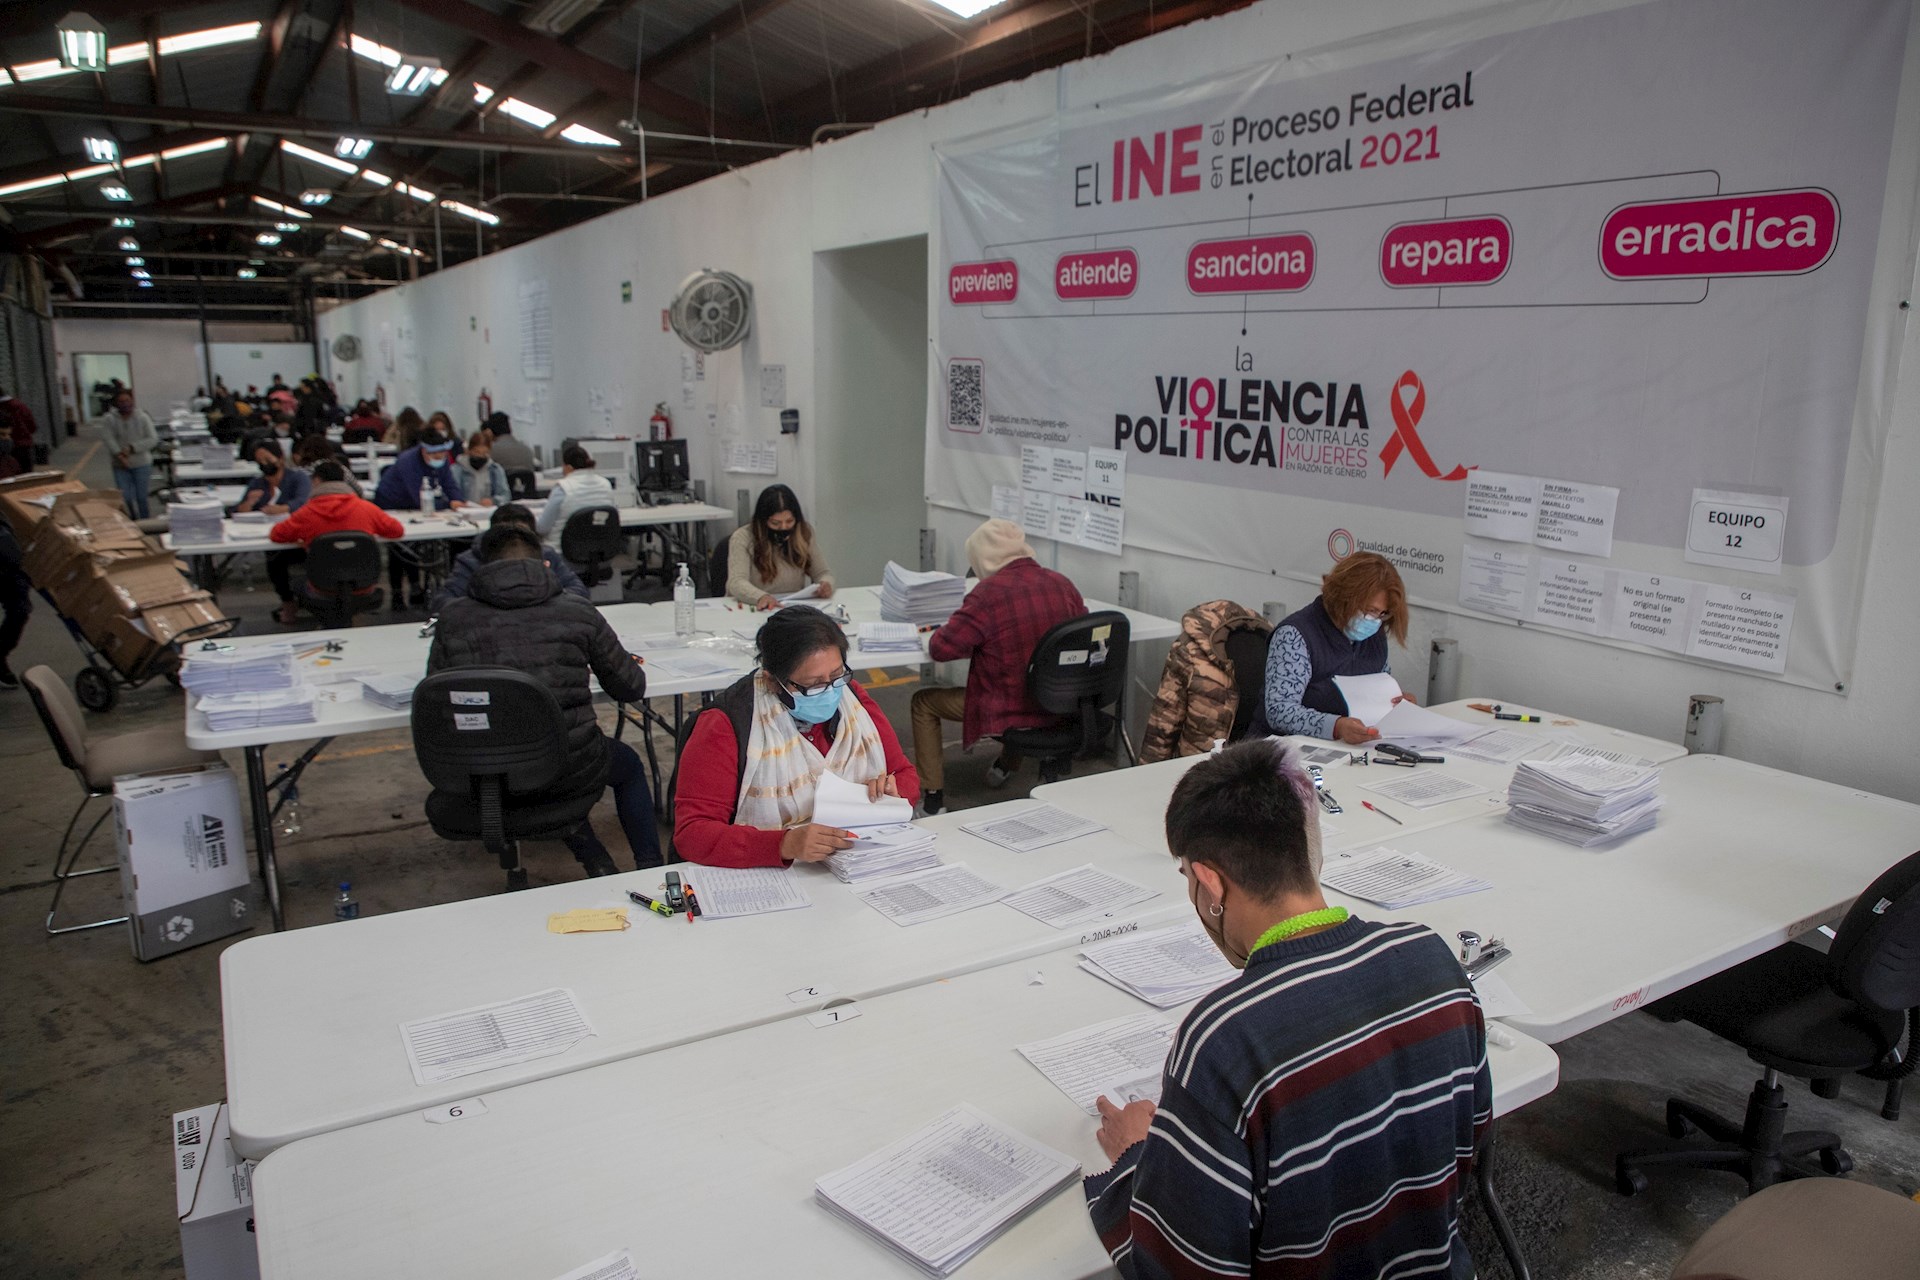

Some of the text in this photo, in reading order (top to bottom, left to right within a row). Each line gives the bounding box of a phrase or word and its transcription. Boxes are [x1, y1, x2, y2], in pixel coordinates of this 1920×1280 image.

[1232, 72, 1475, 147] Proceso Federal
[1111, 124, 1203, 202] INE
[1210, 119, 1225, 189] en el
[1231, 125, 1441, 187] Electoral 2021
[1075, 162, 1102, 207] El
[1614, 209, 1817, 257] erradica
[1193, 246, 1306, 279] sanciona
[1388, 232, 1501, 276] repara
[951, 268, 1013, 295] previene
[1059, 256, 1133, 287] atiende
[1235, 346, 1253, 372] la
[1155, 376, 1369, 429] VIOLENCIA
[1288, 427, 1369, 447] CONTRA LAS
[1286, 442, 1367, 468] MUJERES
[1095, 460, 1119, 471] EQUIPO
[1285, 461, 1367, 479] EN RAZÓN DE GÉNERO
[1102, 474, 1109, 483] 11
[1541, 500, 1571, 509] AMARILLO
[1708, 511, 1766, 529] EQUIPO
[1357, 538, 1445, 563] Igualdad de Género
[1725, 534, 1742, 548] 12
[1568, 564, 1577, 572] C2
[1650, 577, 1660, 585] C3
[1623, 586, 1634, 594] No
[1655, 591, 1685, 604] formato
[1740, 592, 1752, 600] C4
[1633, 600, 1672, 613] original (se
[1705, 600, 1784, 620] Formato incompleto (se
[1629, 611, 1672, 625] presenta en
[1706, 611, 1736, 621] presenta
[1736, 616, 1772, 628] manchado
[1698, 628, 1732, 640] identificar
[1732, 635, 1773, 648] plenamente
[1700, 620, 1731, 630] mutilado
[1755, 629, 1781, 640] posible
[1697, 638, 1737, 651] información
[449, 1106, 463, 1117] 6
[183, 1152, 196, 1170] 4000
